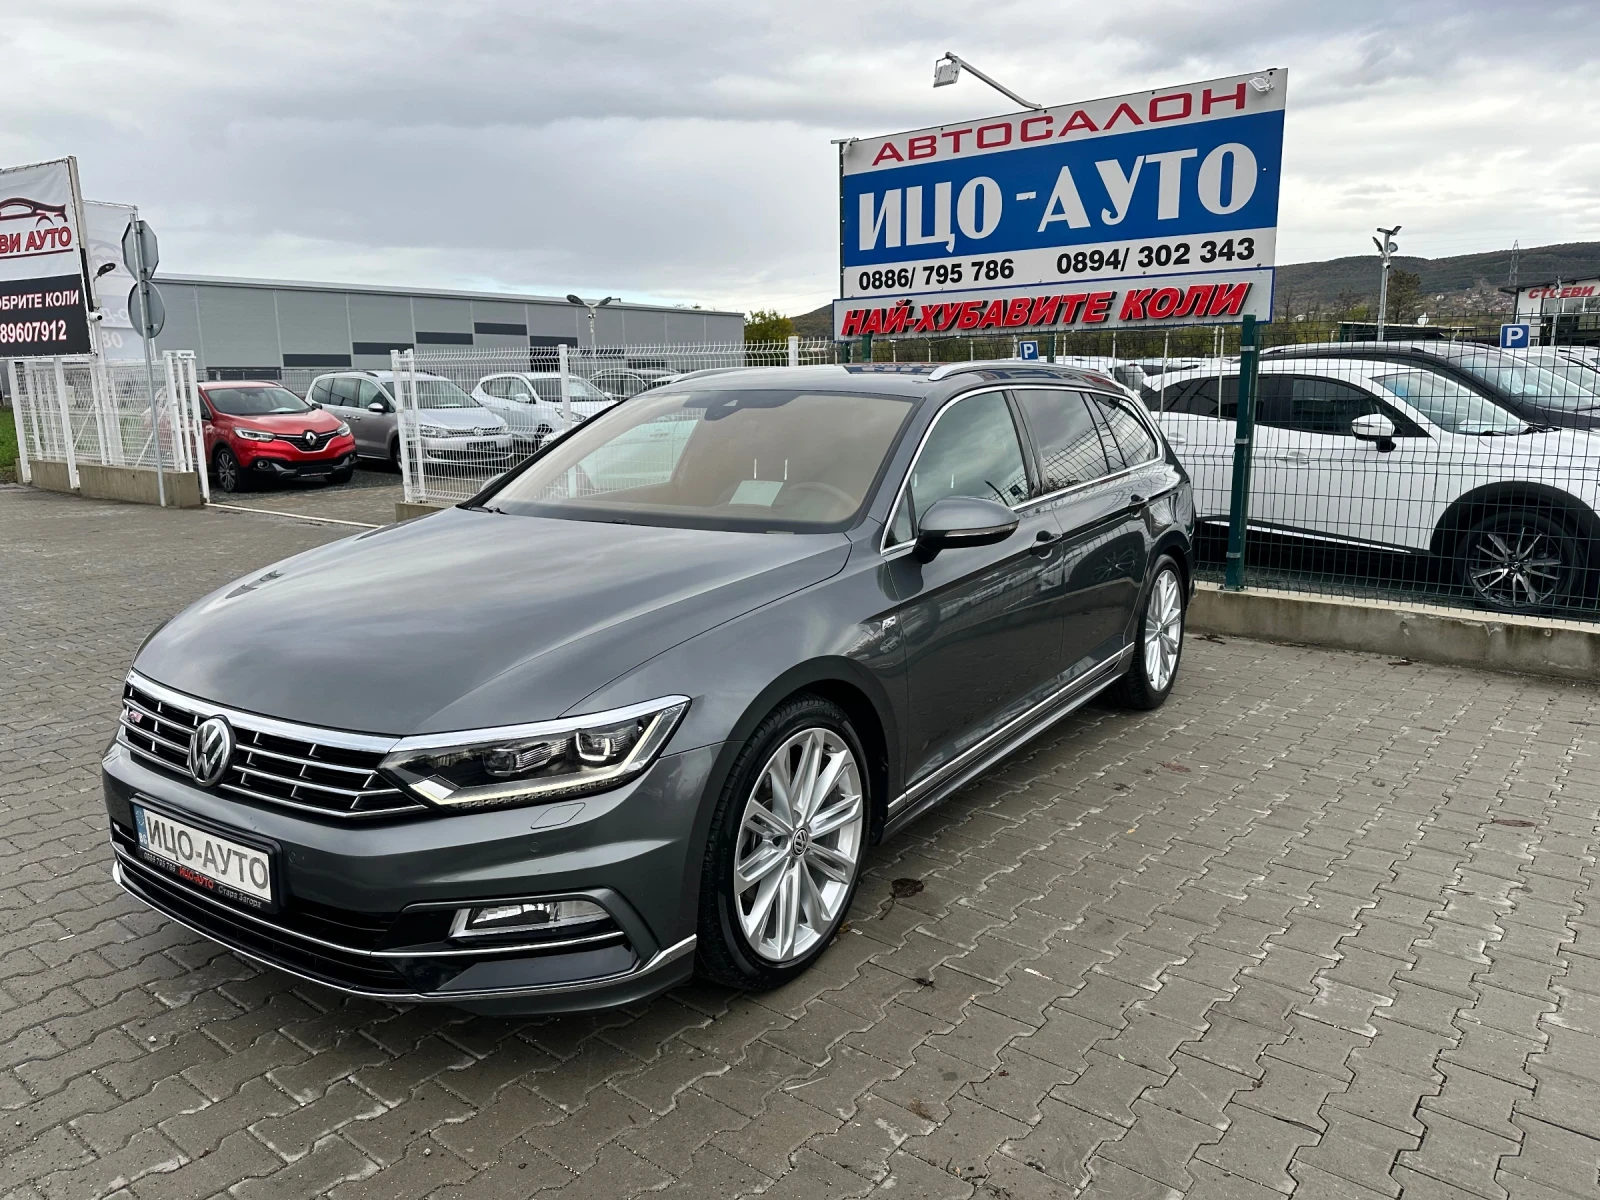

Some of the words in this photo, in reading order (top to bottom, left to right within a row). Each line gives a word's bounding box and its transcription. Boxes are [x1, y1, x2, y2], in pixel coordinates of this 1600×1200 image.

[872, 83, 1246, 166] АВТОСАЛОН
[25, 226, 72, 251] АУТО
[858, 266, 916, 291] 0886/
[922, 263, 963, 284] 795
[971, 259, 1014, 281] 786
[1056, 247, 1130, 275] 0894/
[1137, 242, 1190, 268] 302
[1199, 237, 1255, 262] 343
[45, 289, 79, 307] КОЛИ
[841, 290, 1116, 336] НАЙ-ХУБАВИТЕ
[1119, 282, 1252, 322] КОЛИ
[0, 319, 67, 343] 89607912
[1506, 327, 1523, 346] P
[1023, 344, 1034, 358] P
[147, 816, 268, 890] ИЦО-АУТО
[179, 866, 214, 889] ИЦО-АУТО
[218, 885, 238, 899] Стара
